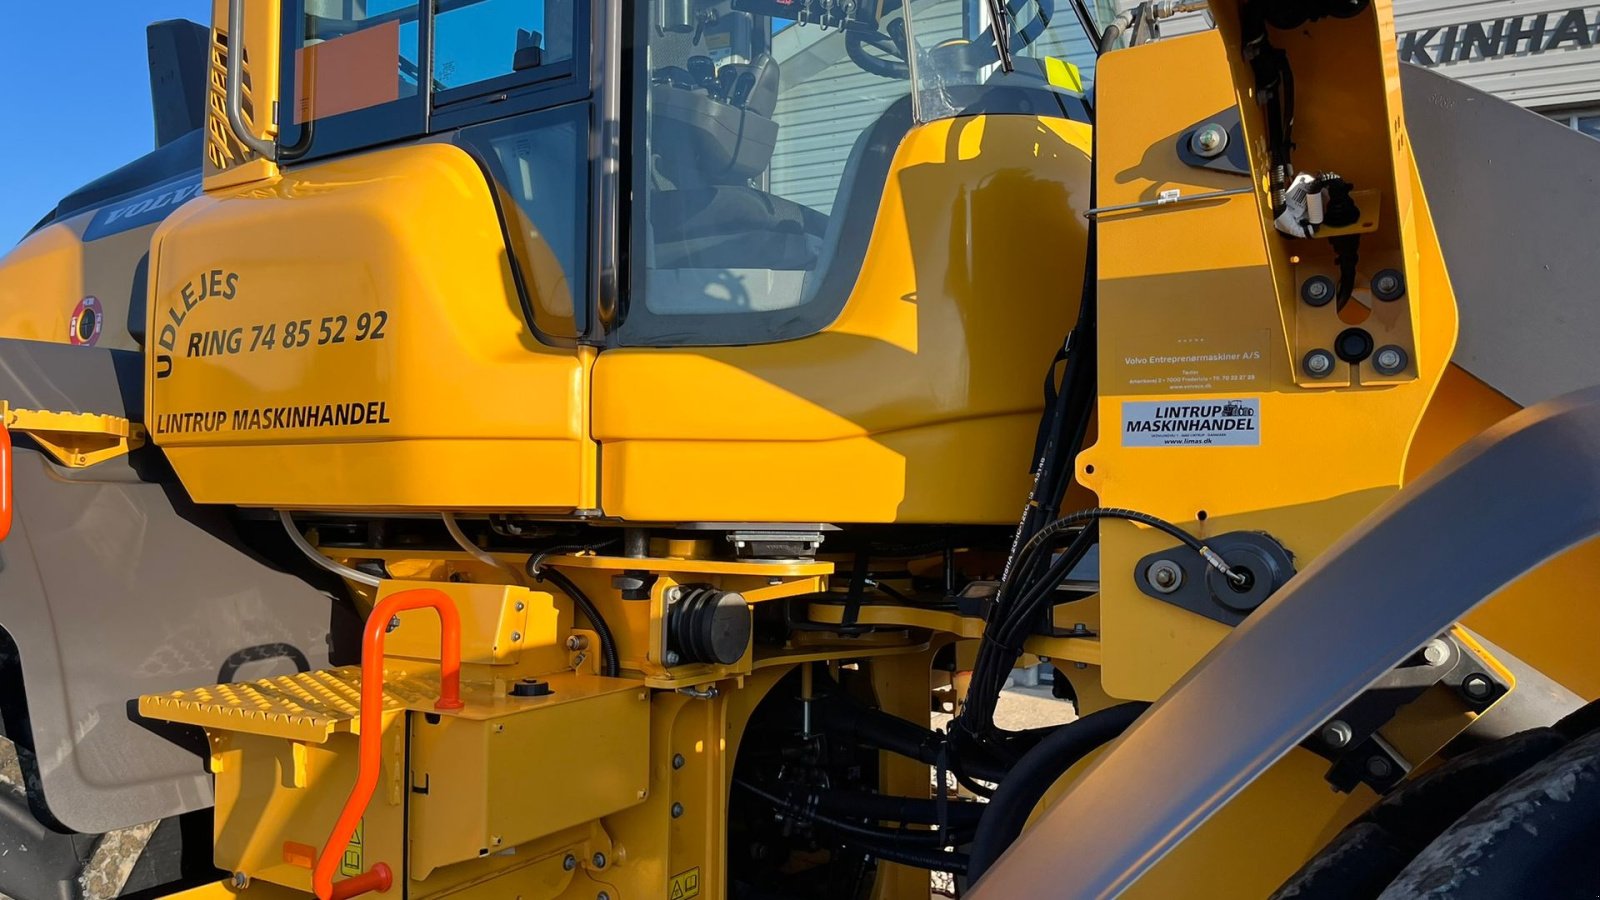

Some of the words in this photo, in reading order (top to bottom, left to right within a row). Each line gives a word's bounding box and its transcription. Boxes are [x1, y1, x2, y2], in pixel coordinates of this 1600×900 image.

[1400, 8, 1600, 67] KINHA
[157, 269, 240, 379] UDLEJES
[187, 327, 243, 358] RING
[250, 324, 276, 352] 74
[282, 319, 312, 349] 85
[317, 315, 348, 345] 52
[355, 310, 388, 341] 92
[1124, 356, 1148, 366] Volvo
[1149, 354, 1240, 365] Entreprenørmaskiner
[1243, 351, 1261, 360] A/S
[157, 411, 227, 434] LINTRUP
[232, 401, 391, 431] MASKINHANDEL
[1126, 418, 1255, 433] MASKINHANDEL
[1155, 405, 1222, 419] LINTRUP
